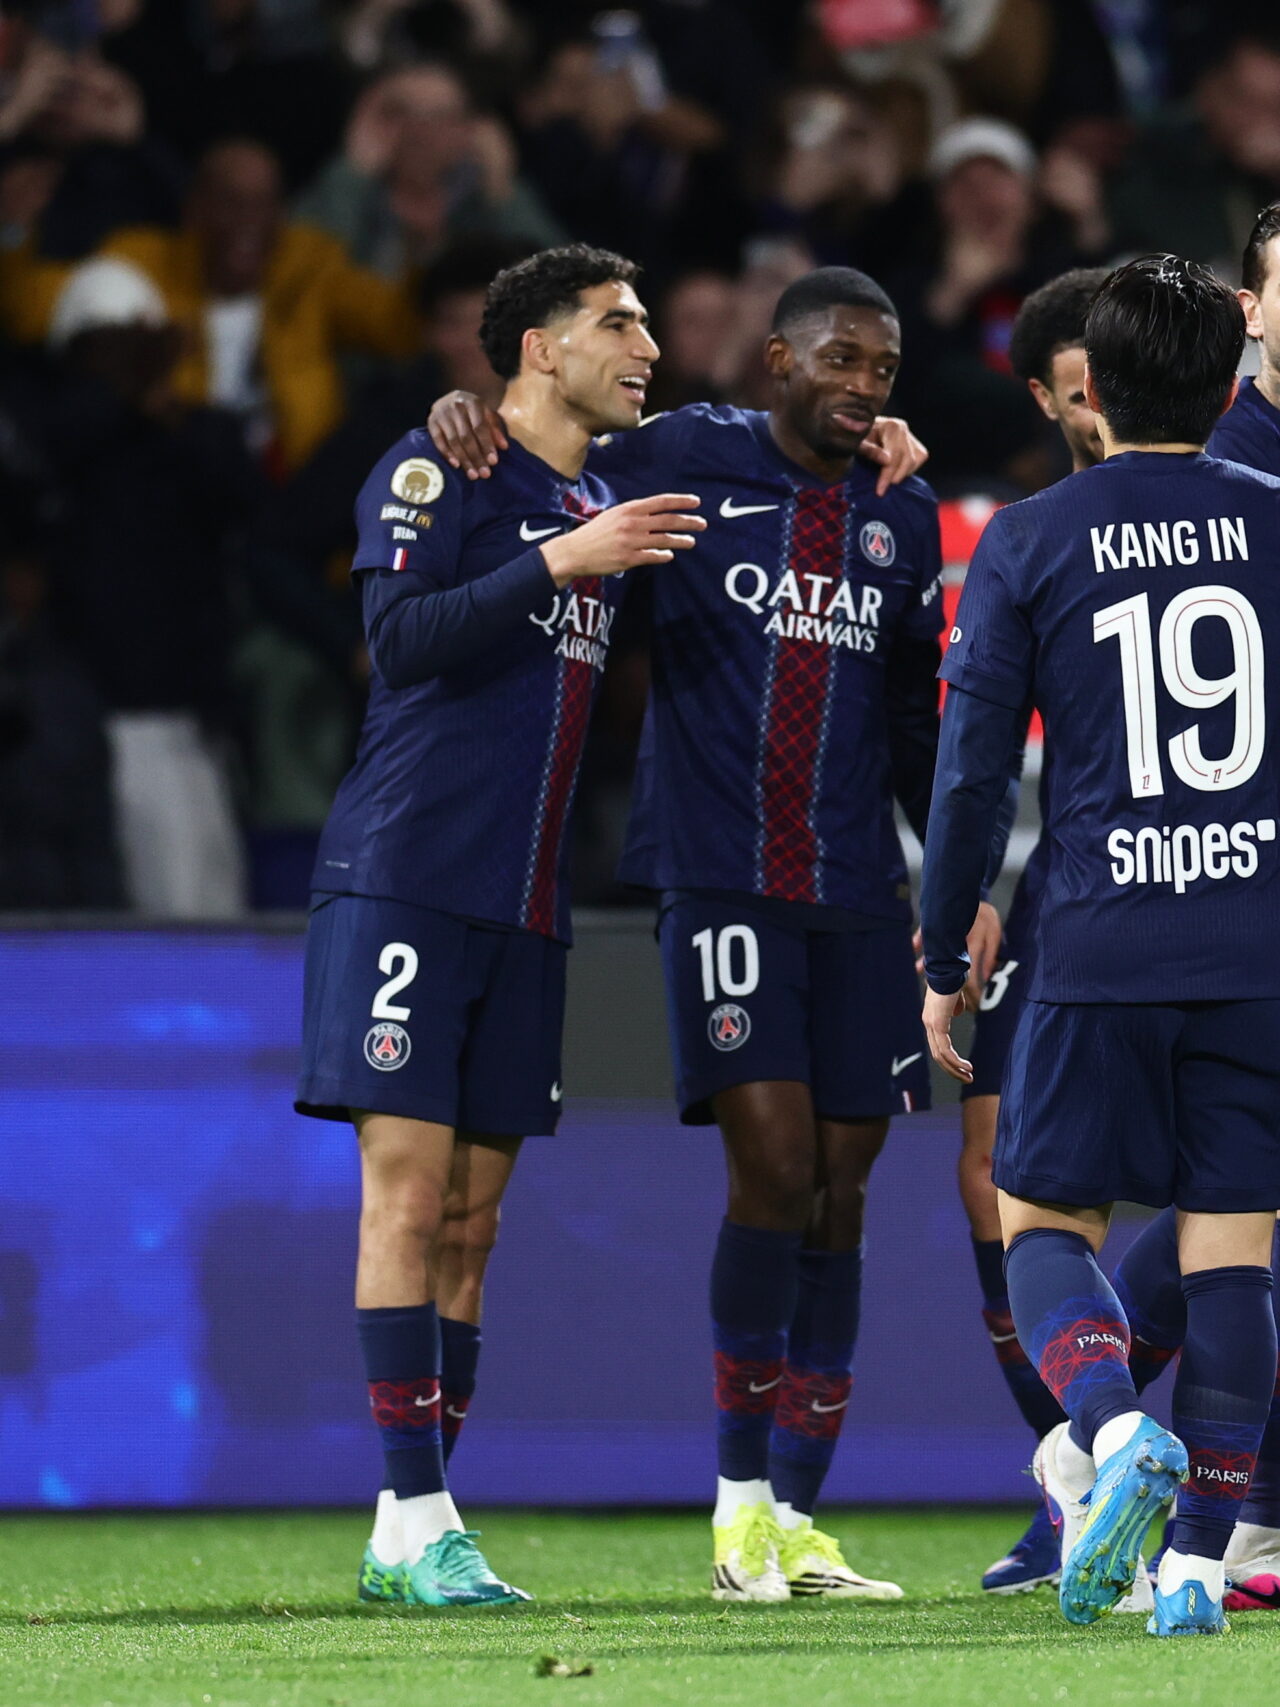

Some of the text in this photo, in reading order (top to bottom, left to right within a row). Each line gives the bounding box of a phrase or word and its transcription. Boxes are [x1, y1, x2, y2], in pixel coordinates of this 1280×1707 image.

[1090, 517, 1249, 573] KANG IN
[724, 563, 883, 628] QATAR
[764, 611, 879, 653] AIRWAYS
[1093, 585, 1266, 799] 19
[1108, 821, 1259, 894] snipes
[371, 943, 419, 1021] 2
[693, 925, 760, 1002] 10
[1077, 1333, 1126, 1354] PARIS
[1197, 1465, 1249, 1485] PARIS
